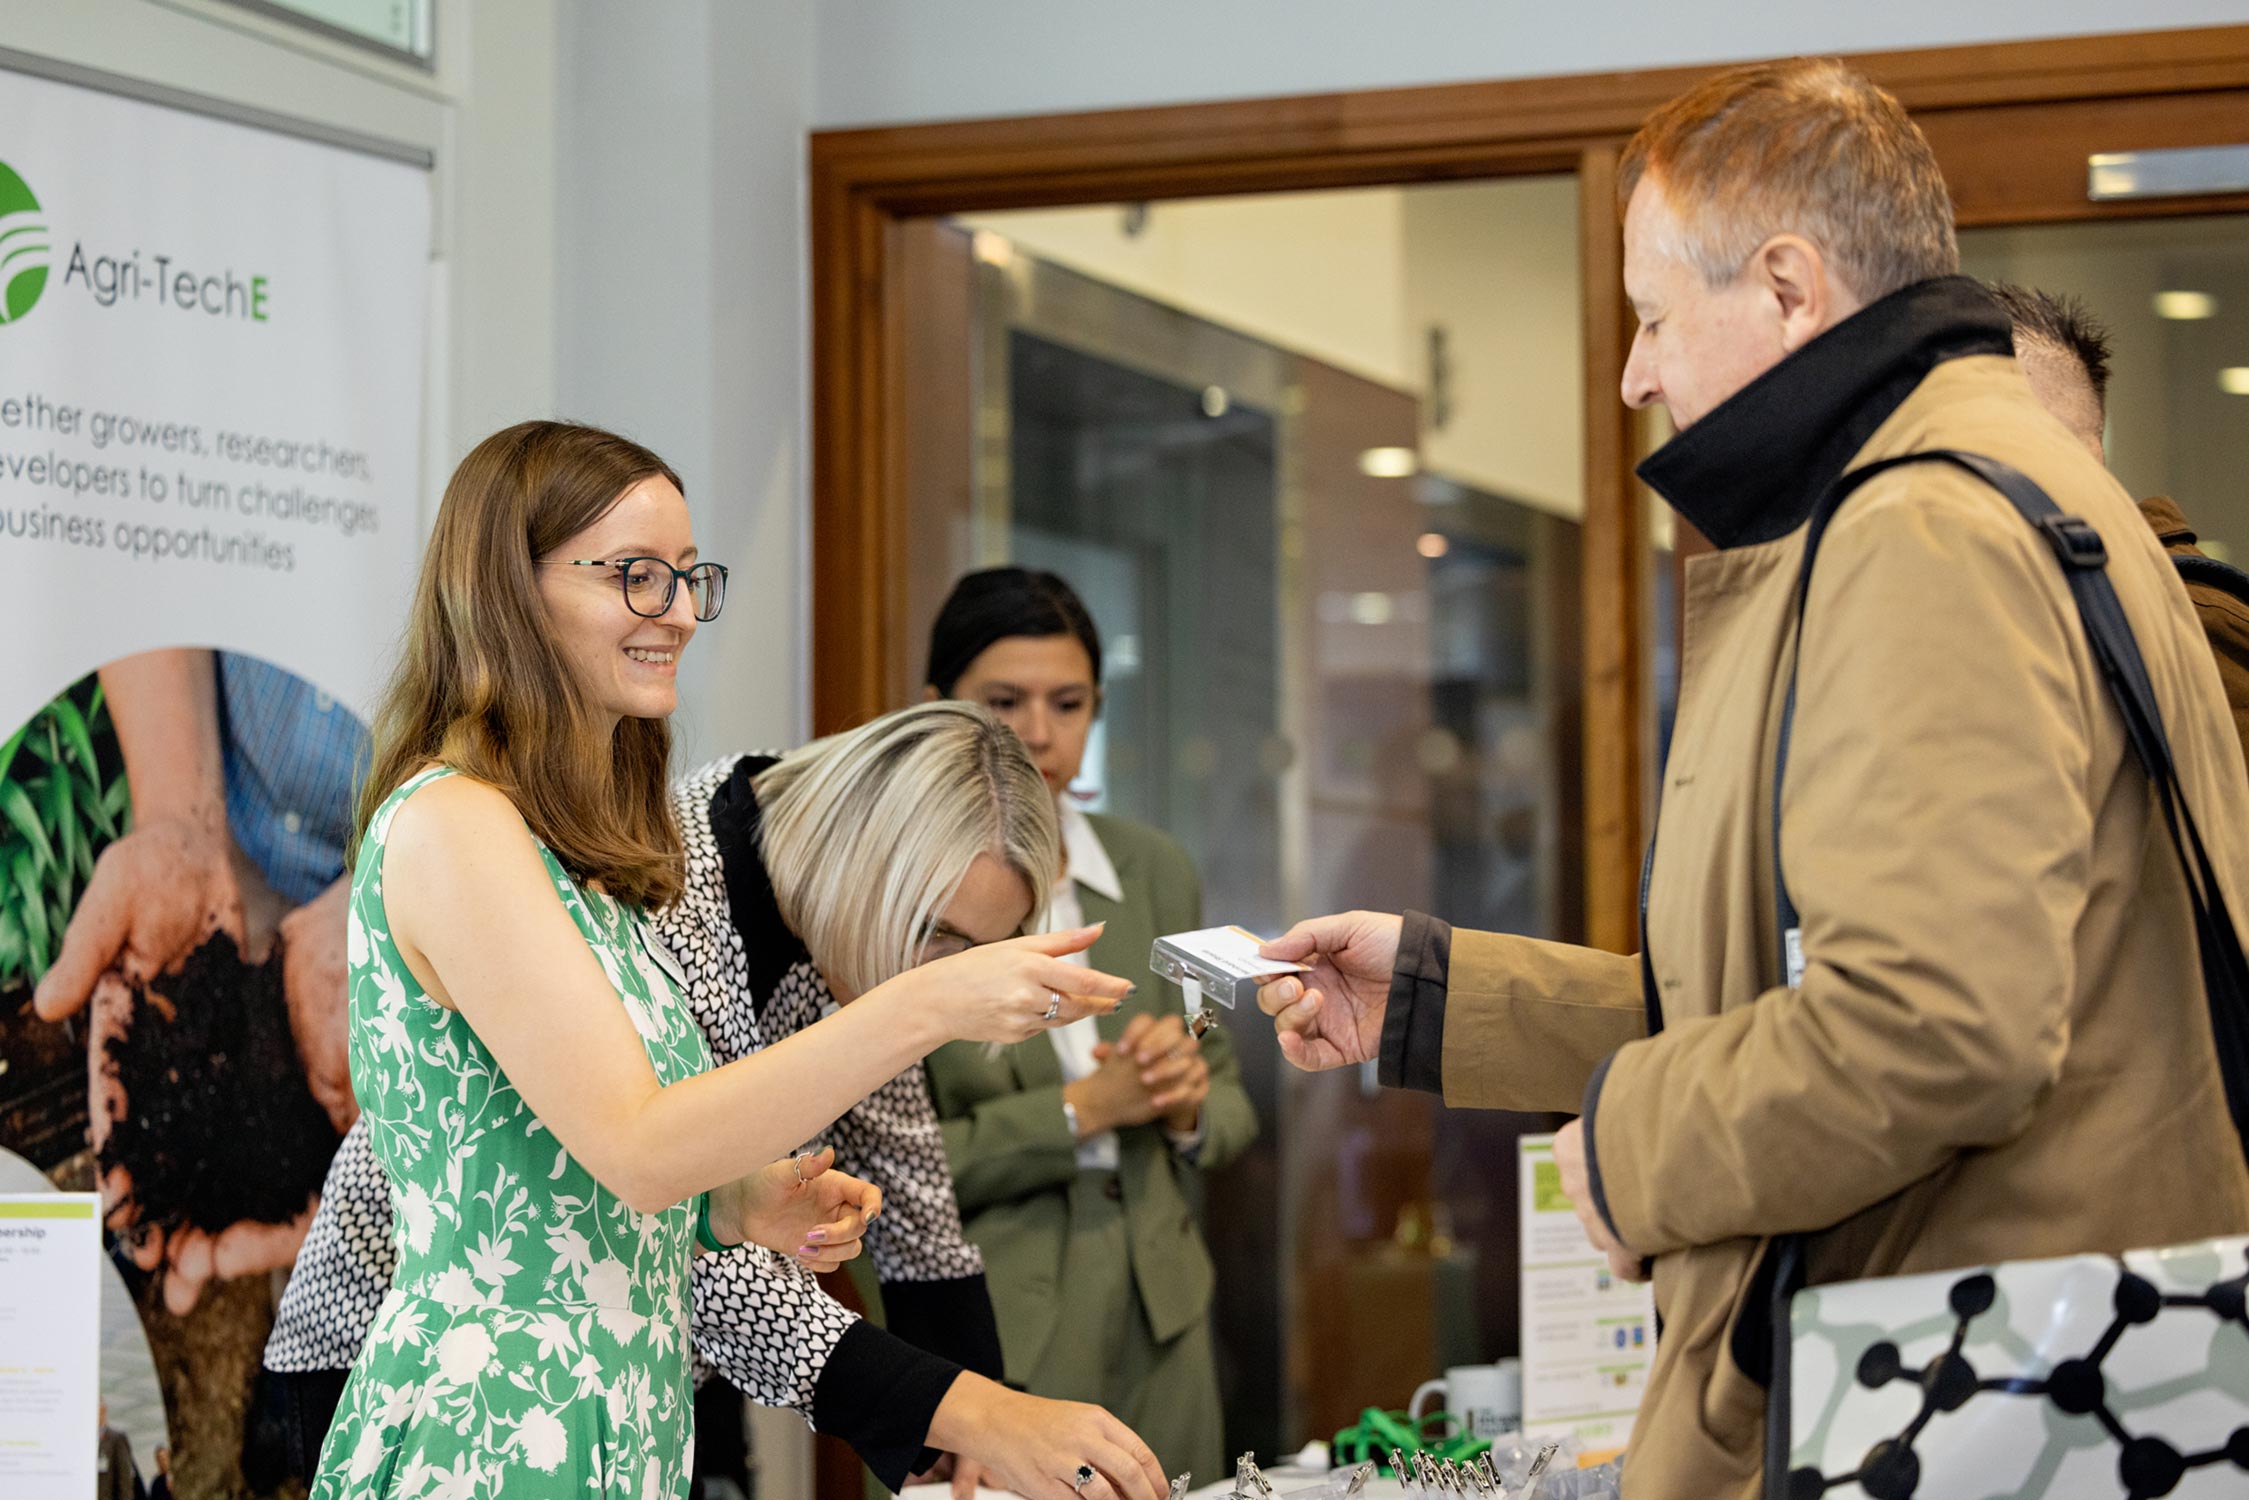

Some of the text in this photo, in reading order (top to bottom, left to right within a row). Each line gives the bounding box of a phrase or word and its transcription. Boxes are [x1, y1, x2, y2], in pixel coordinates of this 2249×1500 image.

[64, 241, 269, 322] Agri-TechE
[1, 394, 83, 435] ether
[90, 410, 209, 458] growers,
[0, 450, 380, 536] velopers to turn challenges
[0, 503, 296, 572] usiness opportunities
[0, 1226, 46, 1240] ership
